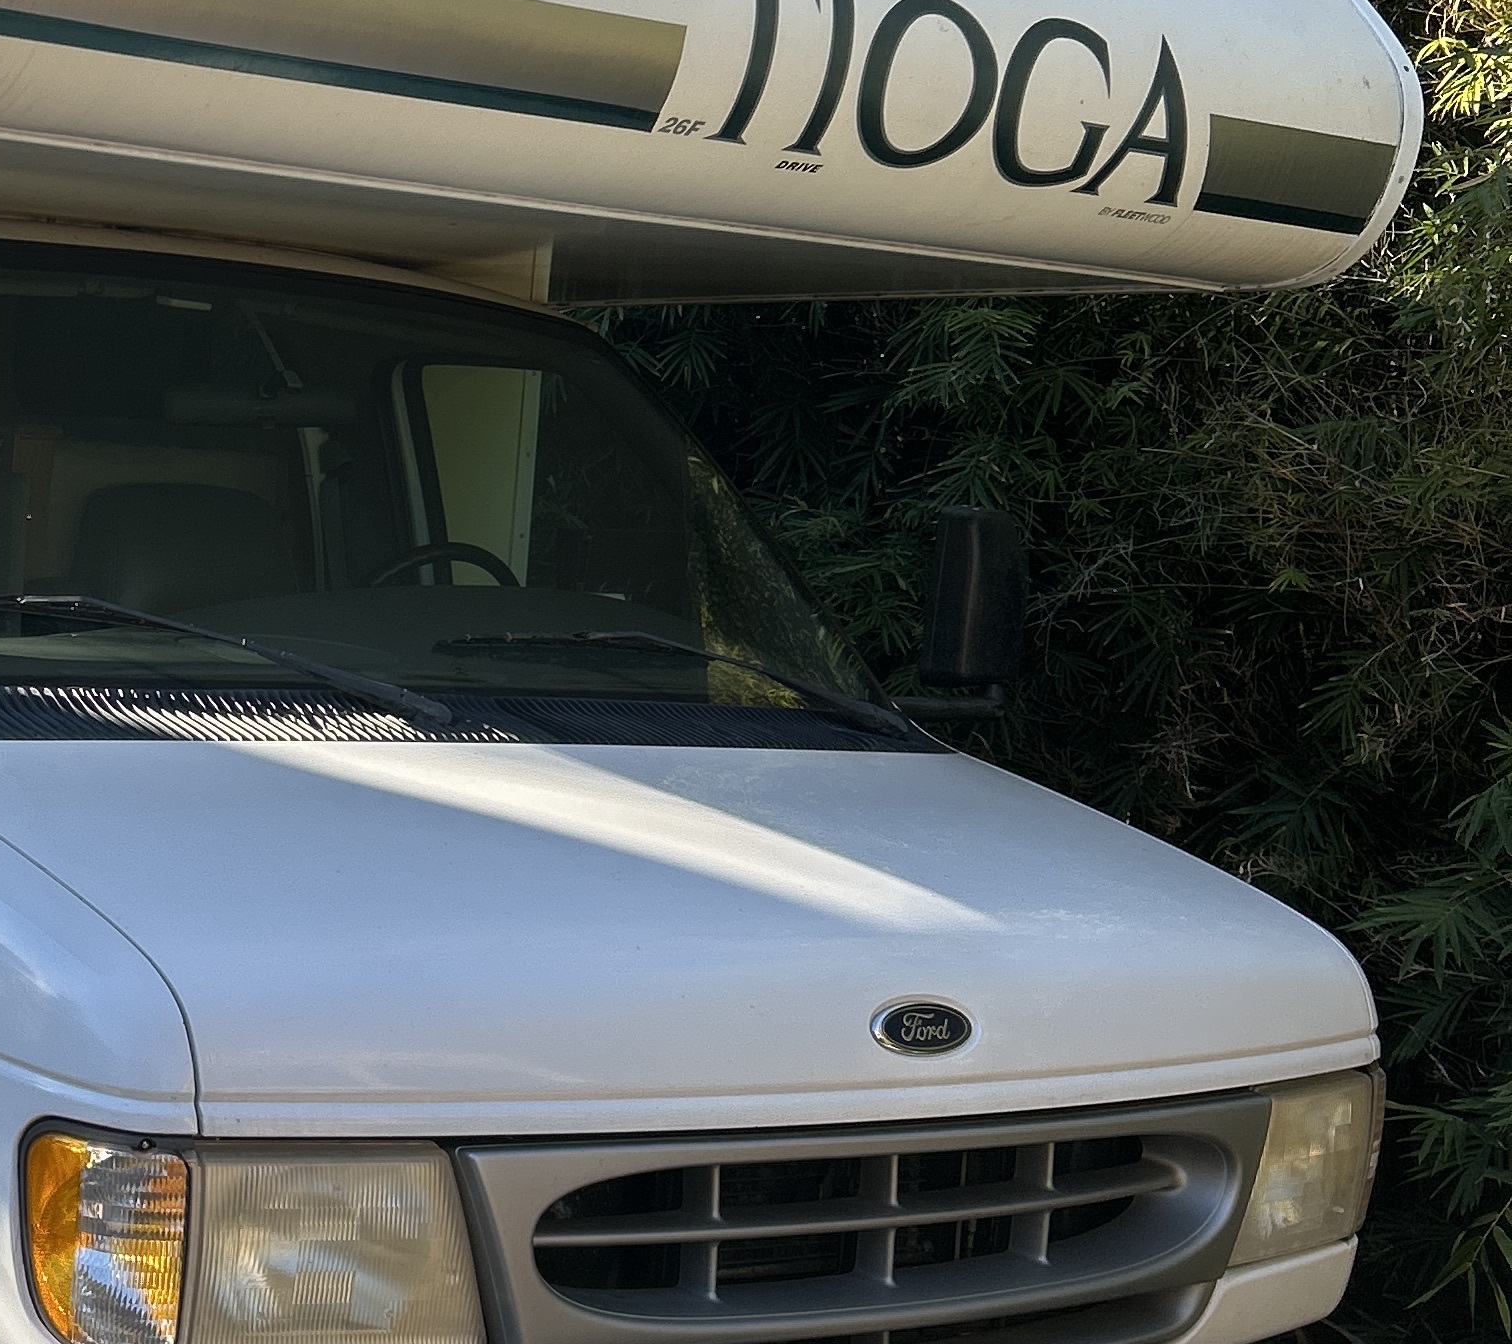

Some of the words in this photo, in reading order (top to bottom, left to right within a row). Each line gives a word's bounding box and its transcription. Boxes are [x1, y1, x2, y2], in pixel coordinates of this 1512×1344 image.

[657, 116, 706, 136] 26F
[774, 160, 824, 174] DRIVE
[901, 1012, 950, 1041] Ford
